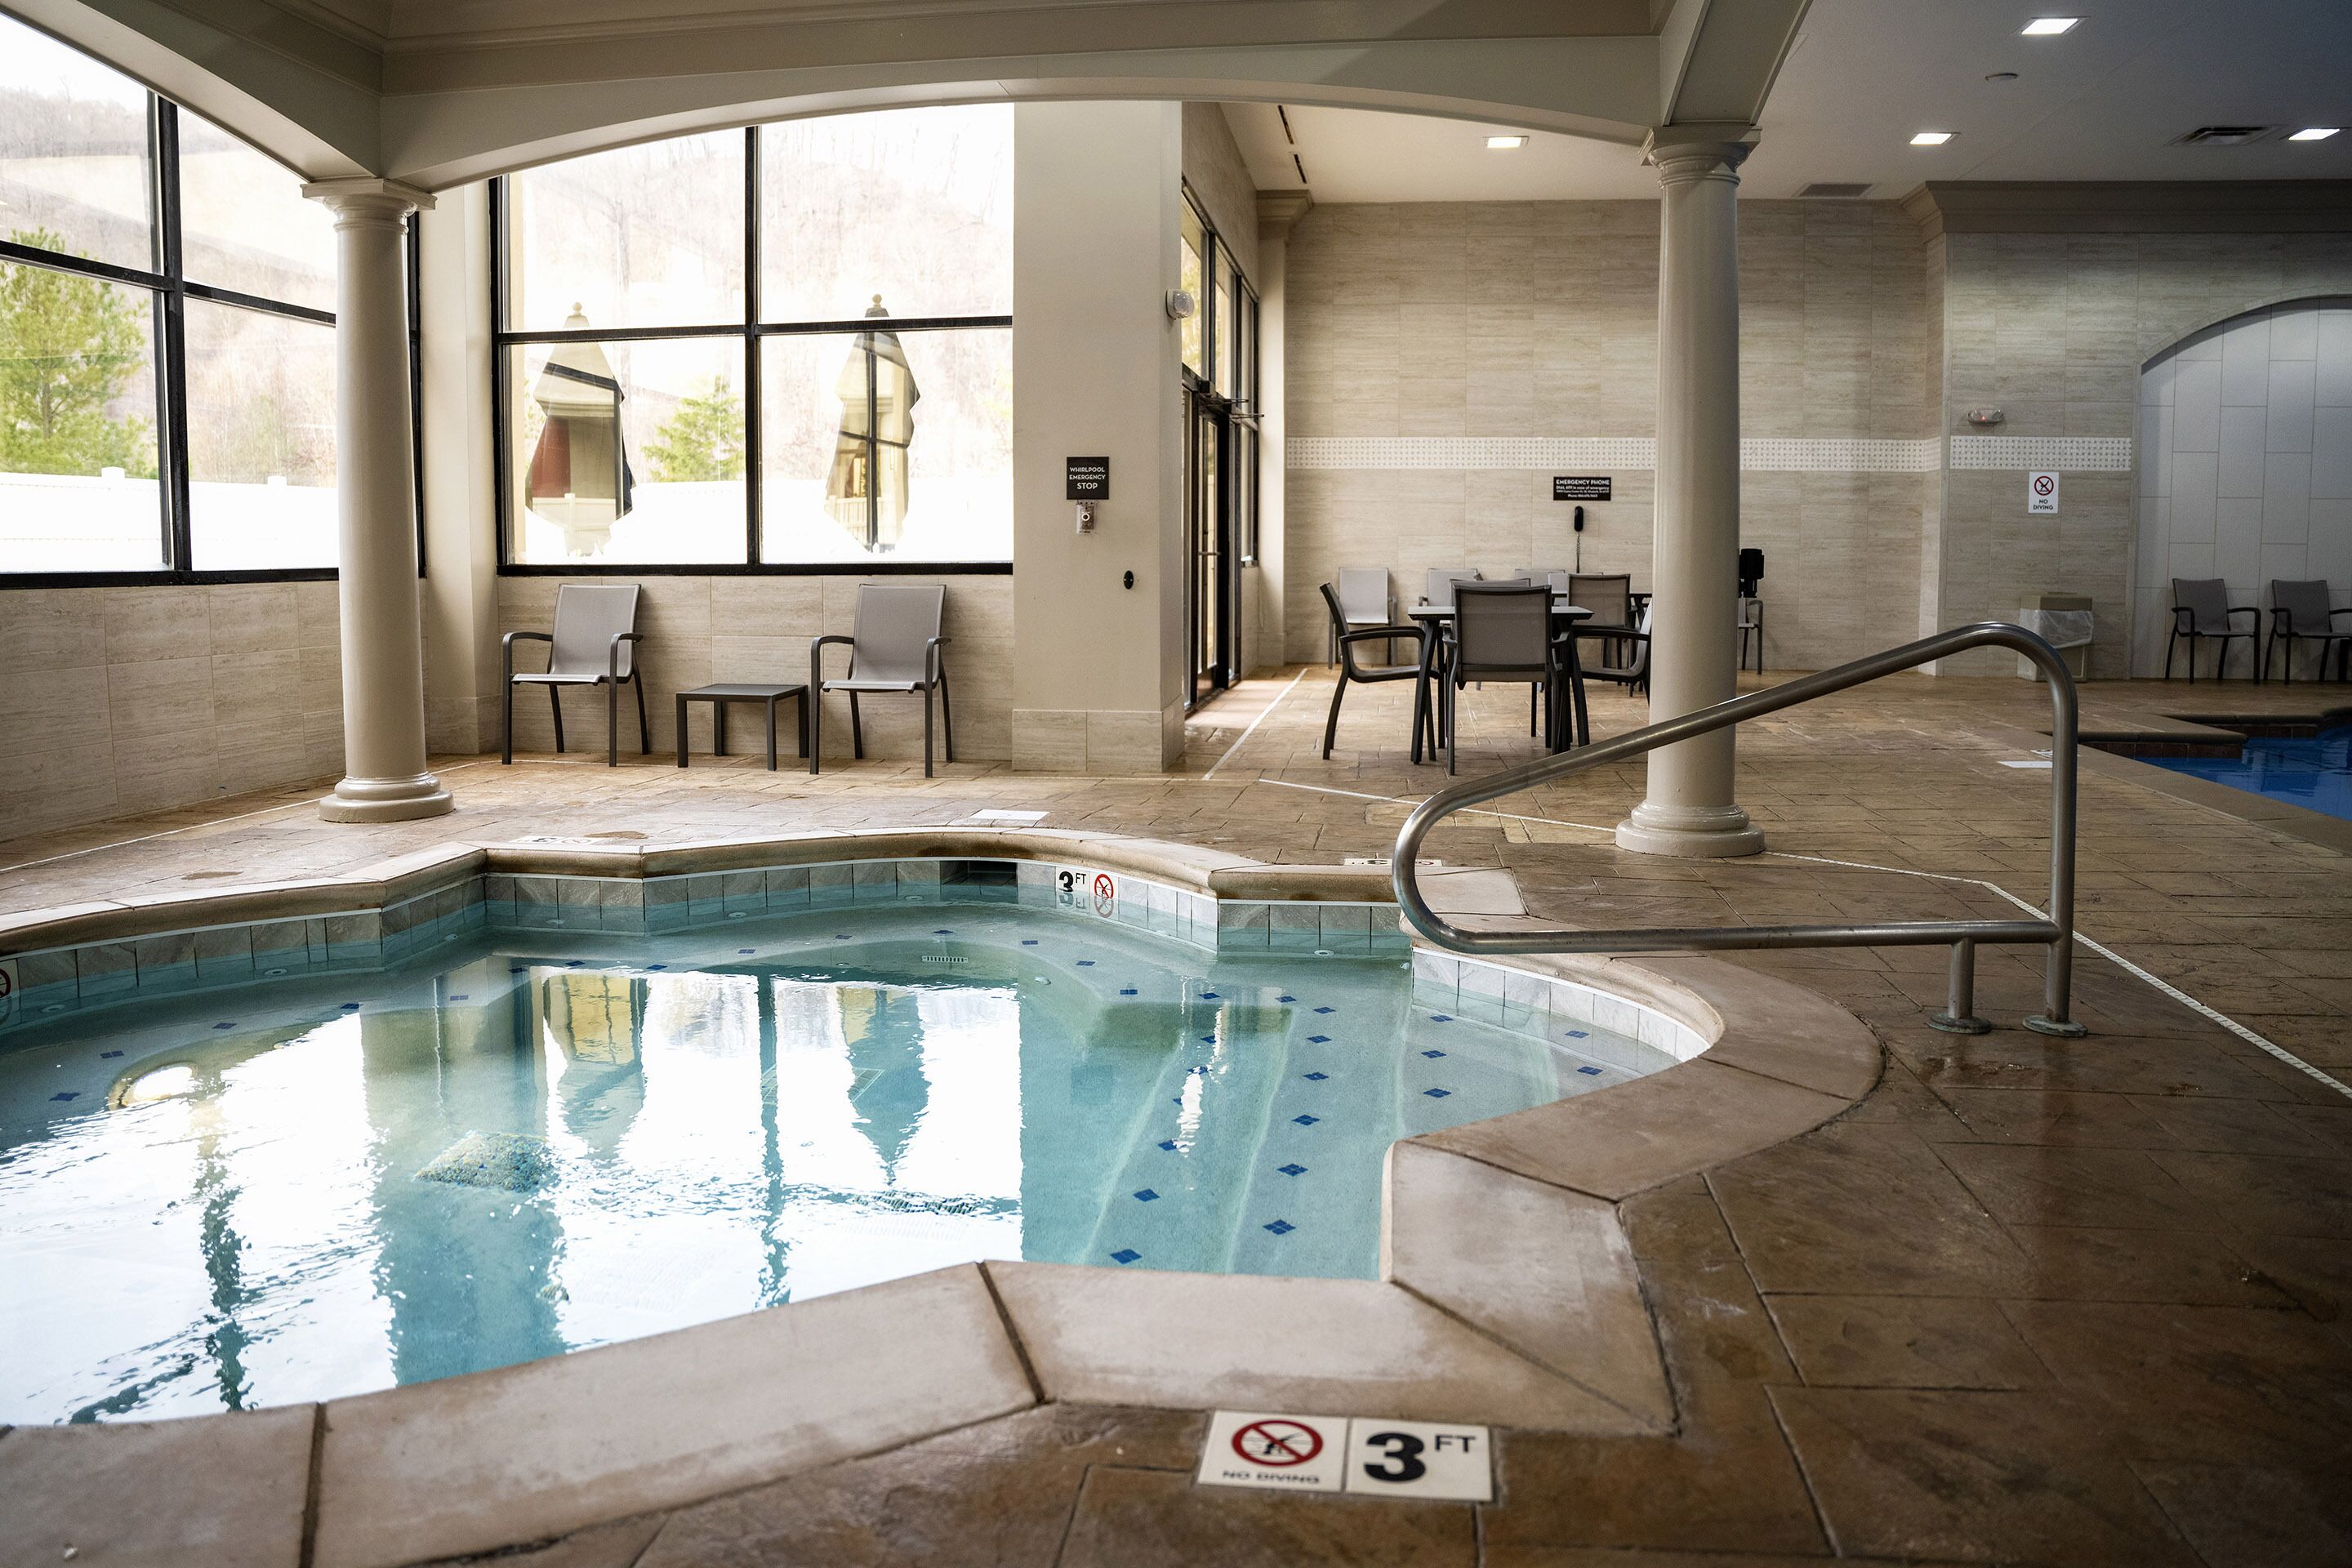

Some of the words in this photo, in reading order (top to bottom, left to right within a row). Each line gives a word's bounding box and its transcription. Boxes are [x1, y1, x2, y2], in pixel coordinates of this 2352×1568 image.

[1076, 482, 1098, 490] STOP
[1058, 871, 1074, 893] 3
[1076, 872, 1087, 884] FT
[1363, 1431, 1427, 1483] 3
[1434, 1434, 1477, 1454] FT
[1222, 1469, 1250, 1481] NO
[1255, 1471, 1321, 1485] DIVING
